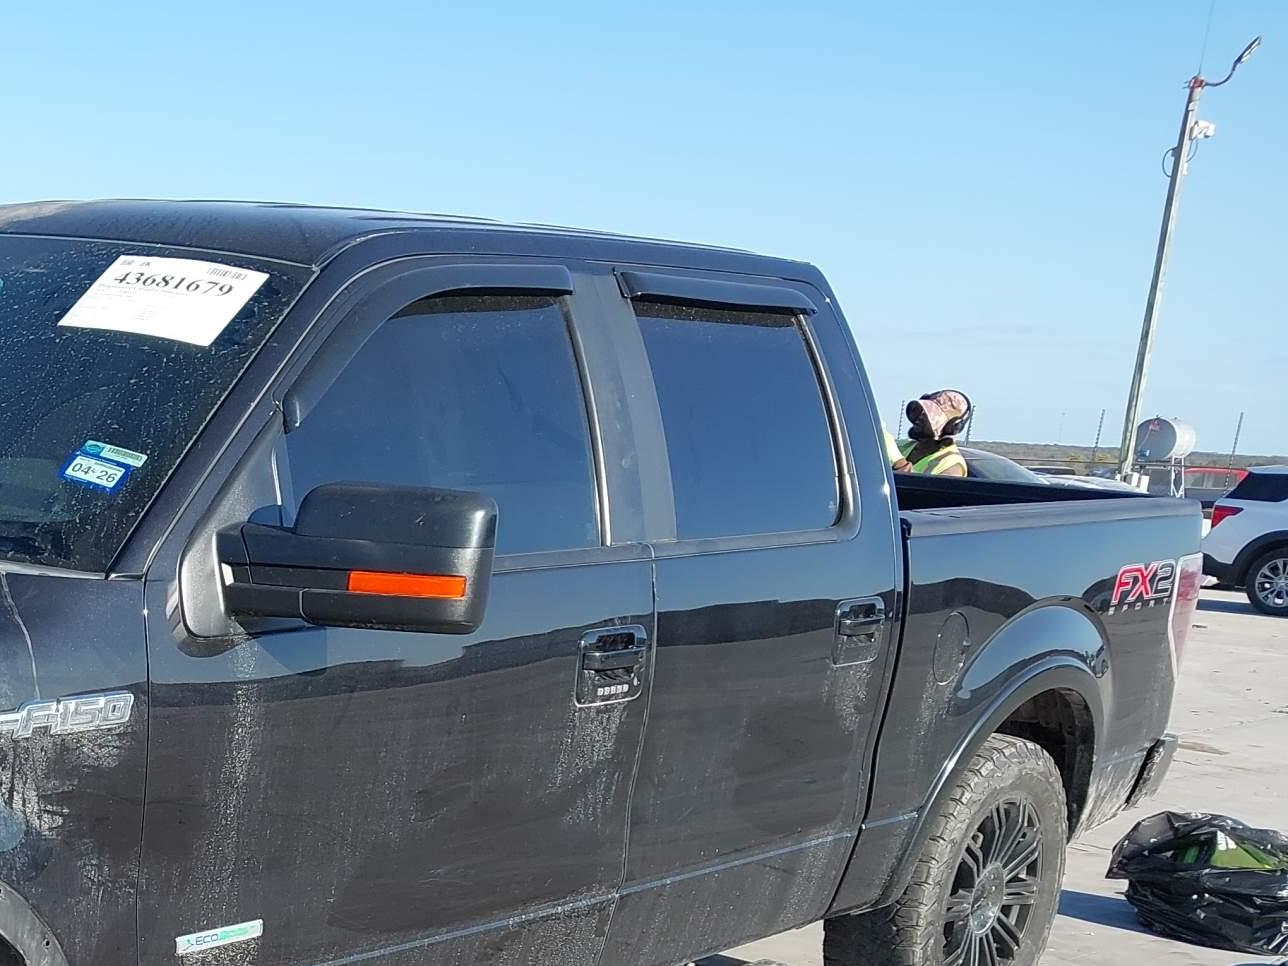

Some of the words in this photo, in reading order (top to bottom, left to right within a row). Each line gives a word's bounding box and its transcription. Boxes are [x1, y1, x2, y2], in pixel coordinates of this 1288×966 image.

[114, 270, 234, 297] 43681679
[71, 462, 92, 475] 04
[95, 469, 118, 483] 26
[1111, 559, 1176, 605] FX2
